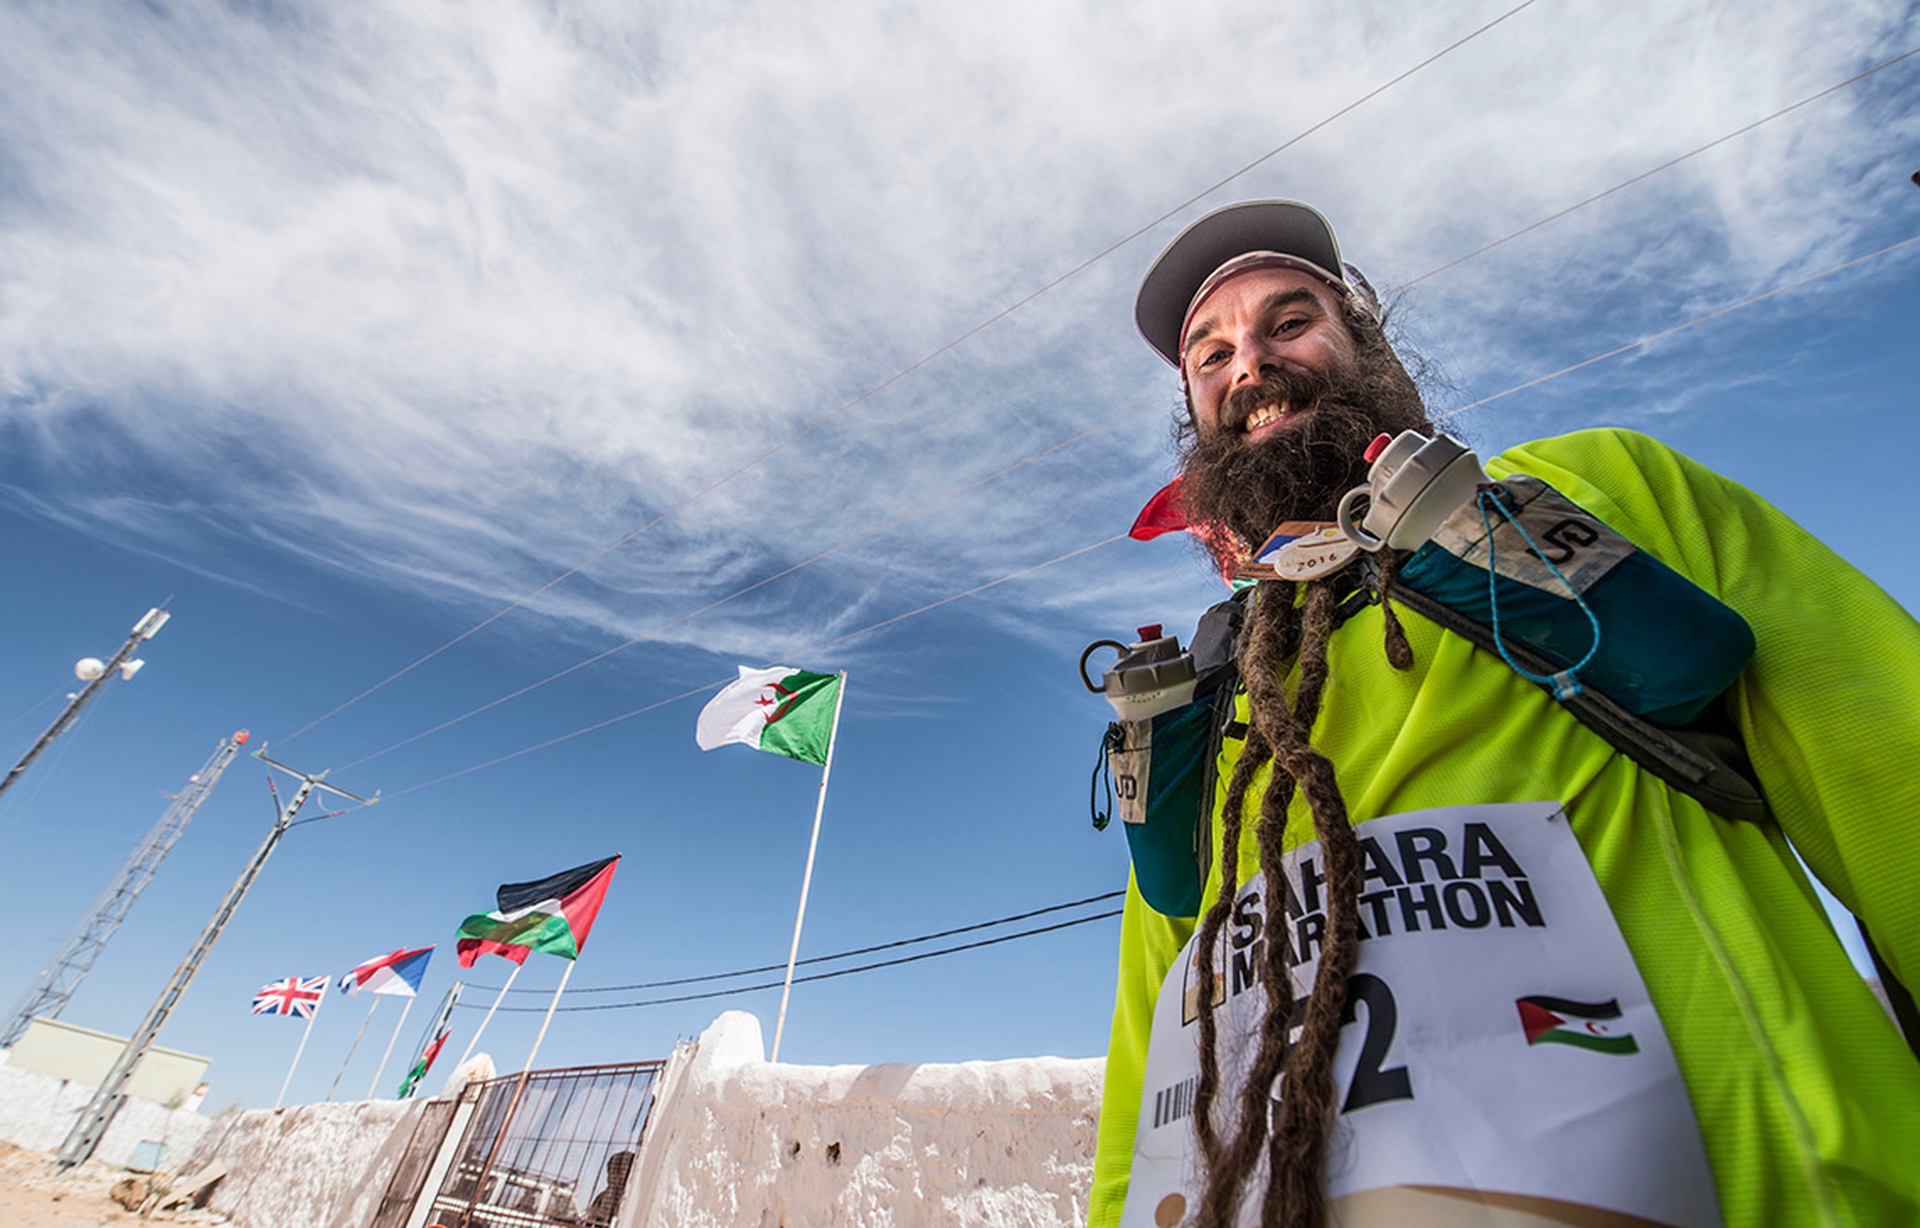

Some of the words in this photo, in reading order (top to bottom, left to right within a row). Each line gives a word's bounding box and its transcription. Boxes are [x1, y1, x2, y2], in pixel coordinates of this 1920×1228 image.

[1296, 553, 1338, 573] 2016
[1231, 822, 1528, 950] SHARA
[1231, 880, 1547, 997] MRTHON
